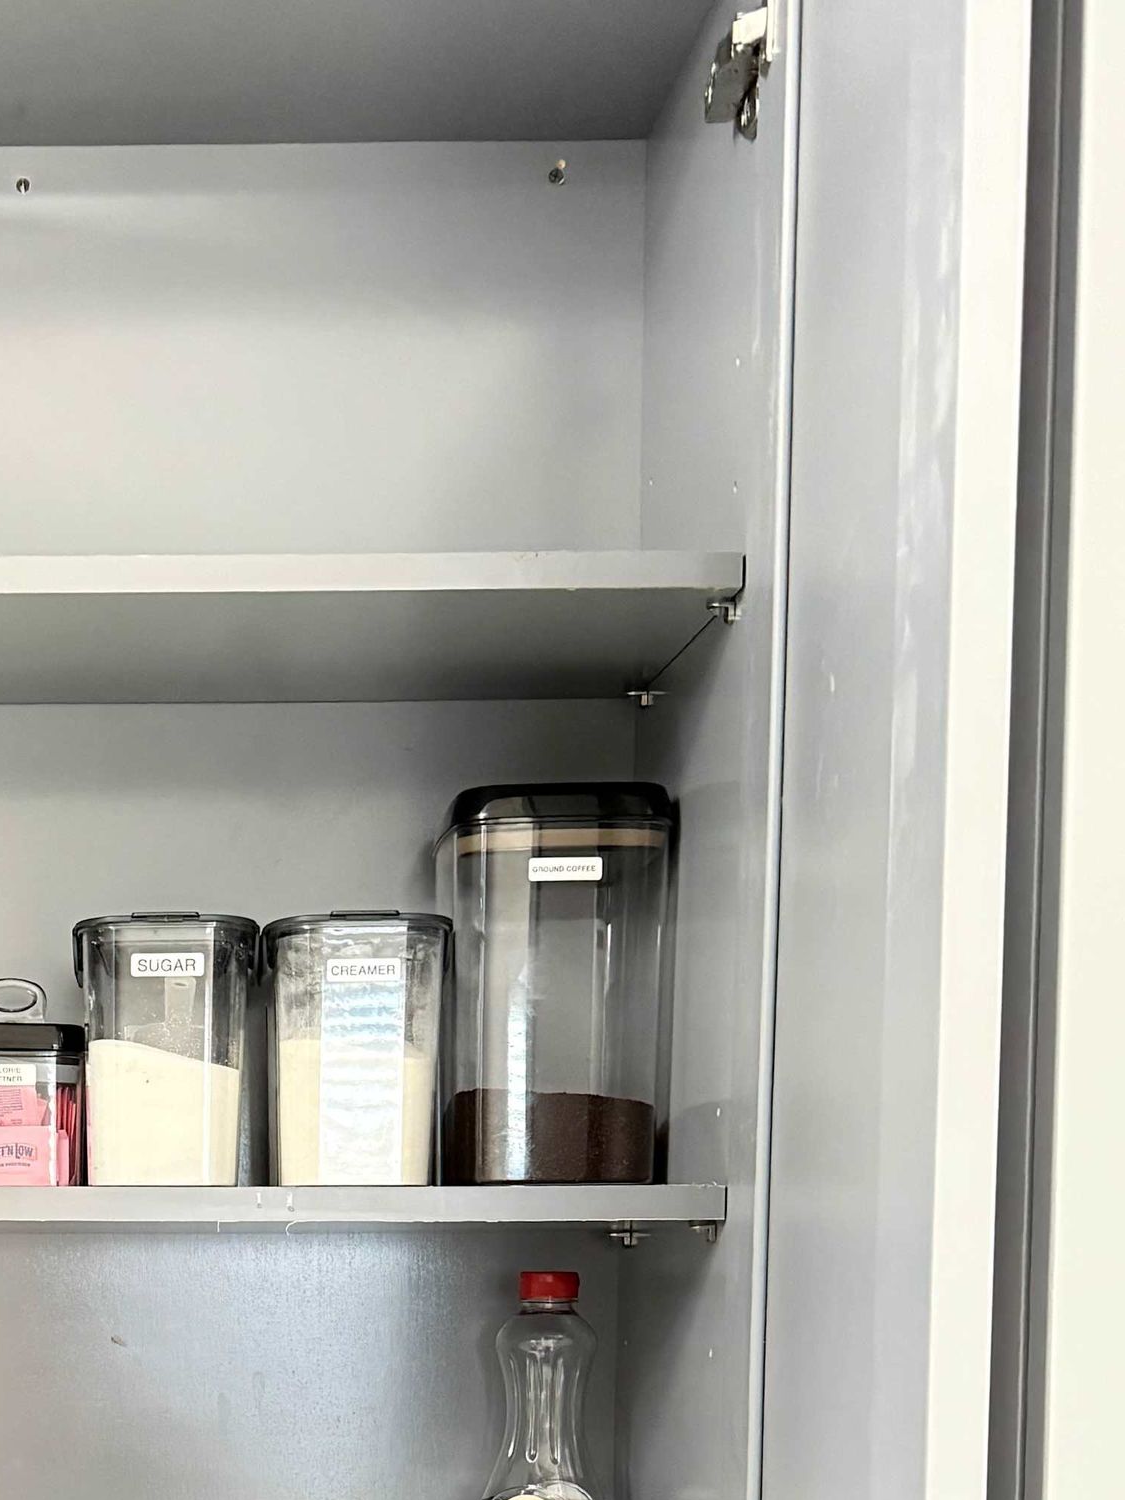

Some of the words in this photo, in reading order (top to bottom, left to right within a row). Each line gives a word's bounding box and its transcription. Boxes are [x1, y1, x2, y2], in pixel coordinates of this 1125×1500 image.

[566, 865, 596, 873] COFFEE
[137, 958, 196, 972] SUGAR
[331, 964, 395, 976] CREAMER
